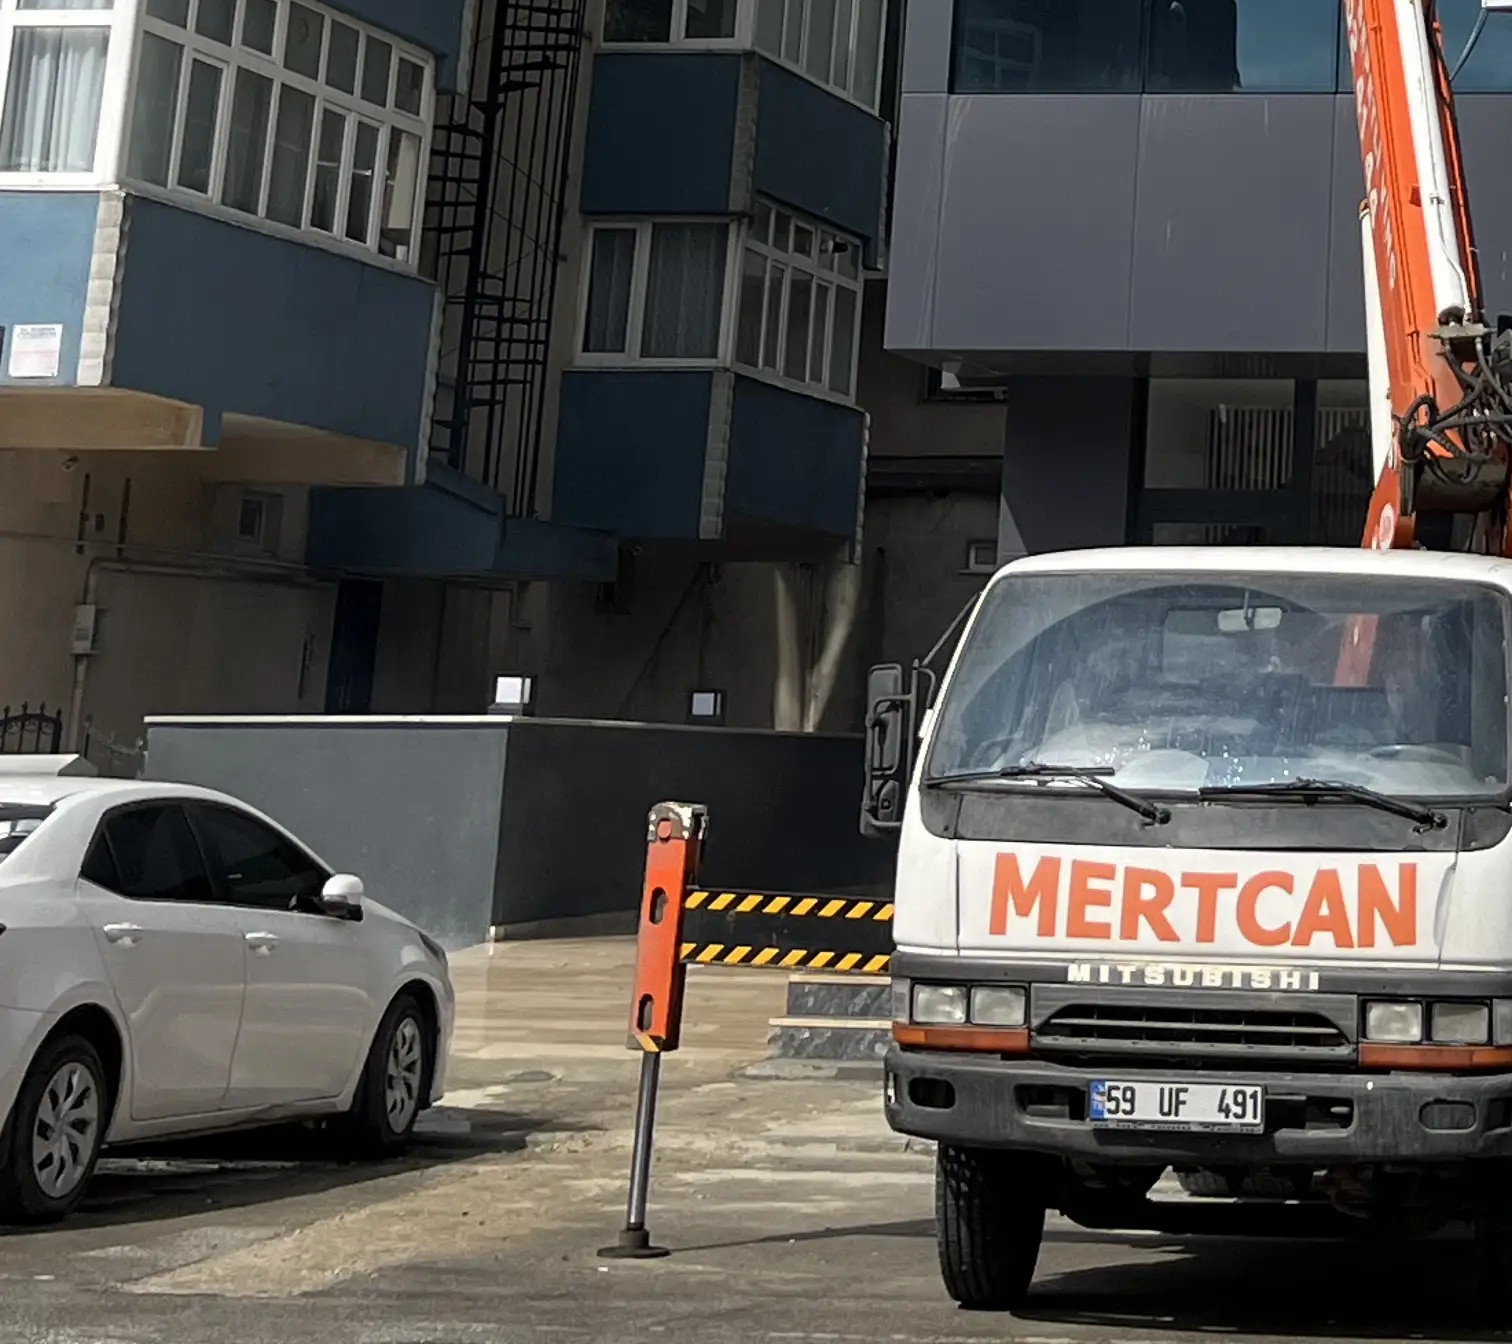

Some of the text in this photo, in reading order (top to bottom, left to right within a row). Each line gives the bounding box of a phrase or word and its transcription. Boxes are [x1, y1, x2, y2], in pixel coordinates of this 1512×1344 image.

[988, 851, 1418, 949] MERTCAN
[1066, 962, 1320, 992] MITSUBISHI
[1106, 1084, 1259, 1120] 59 UF 491
